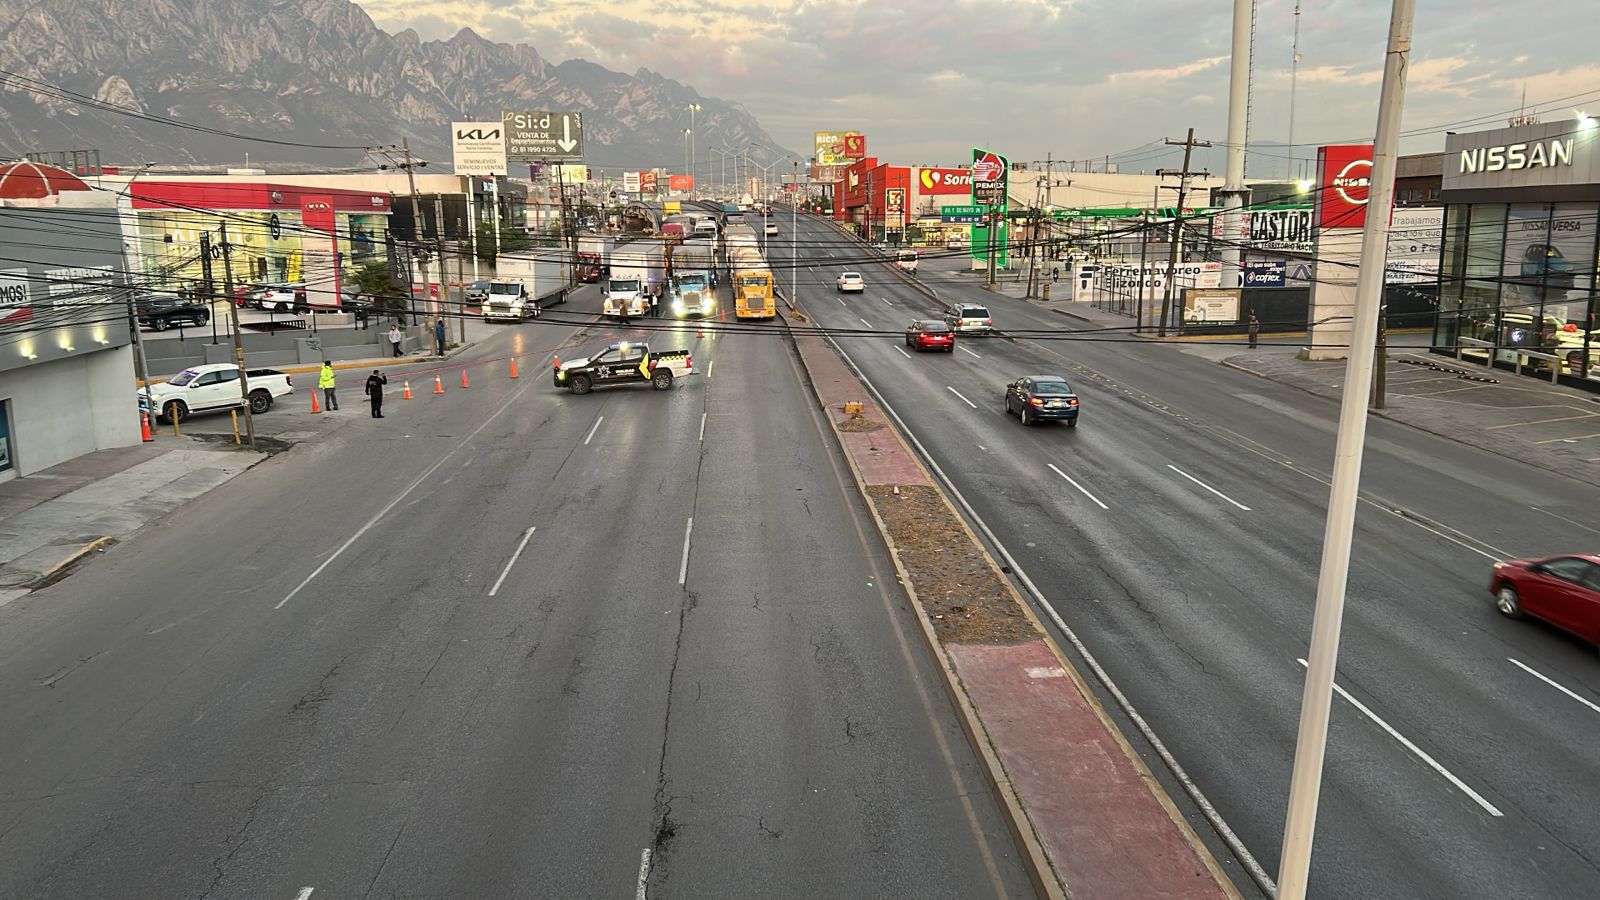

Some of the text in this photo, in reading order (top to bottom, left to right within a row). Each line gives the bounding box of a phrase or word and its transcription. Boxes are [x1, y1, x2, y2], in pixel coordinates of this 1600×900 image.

[514, 114, 550, 129] Si:d
[510, 138, 556, 146] Departamentos
[1460, 138, 1574, 174] NISSAN
[1393, 216, 1441, 226] Trabajamos
[1552, 220, 1581, 231] VERSA
[1425, 230, 1441, 238] que
